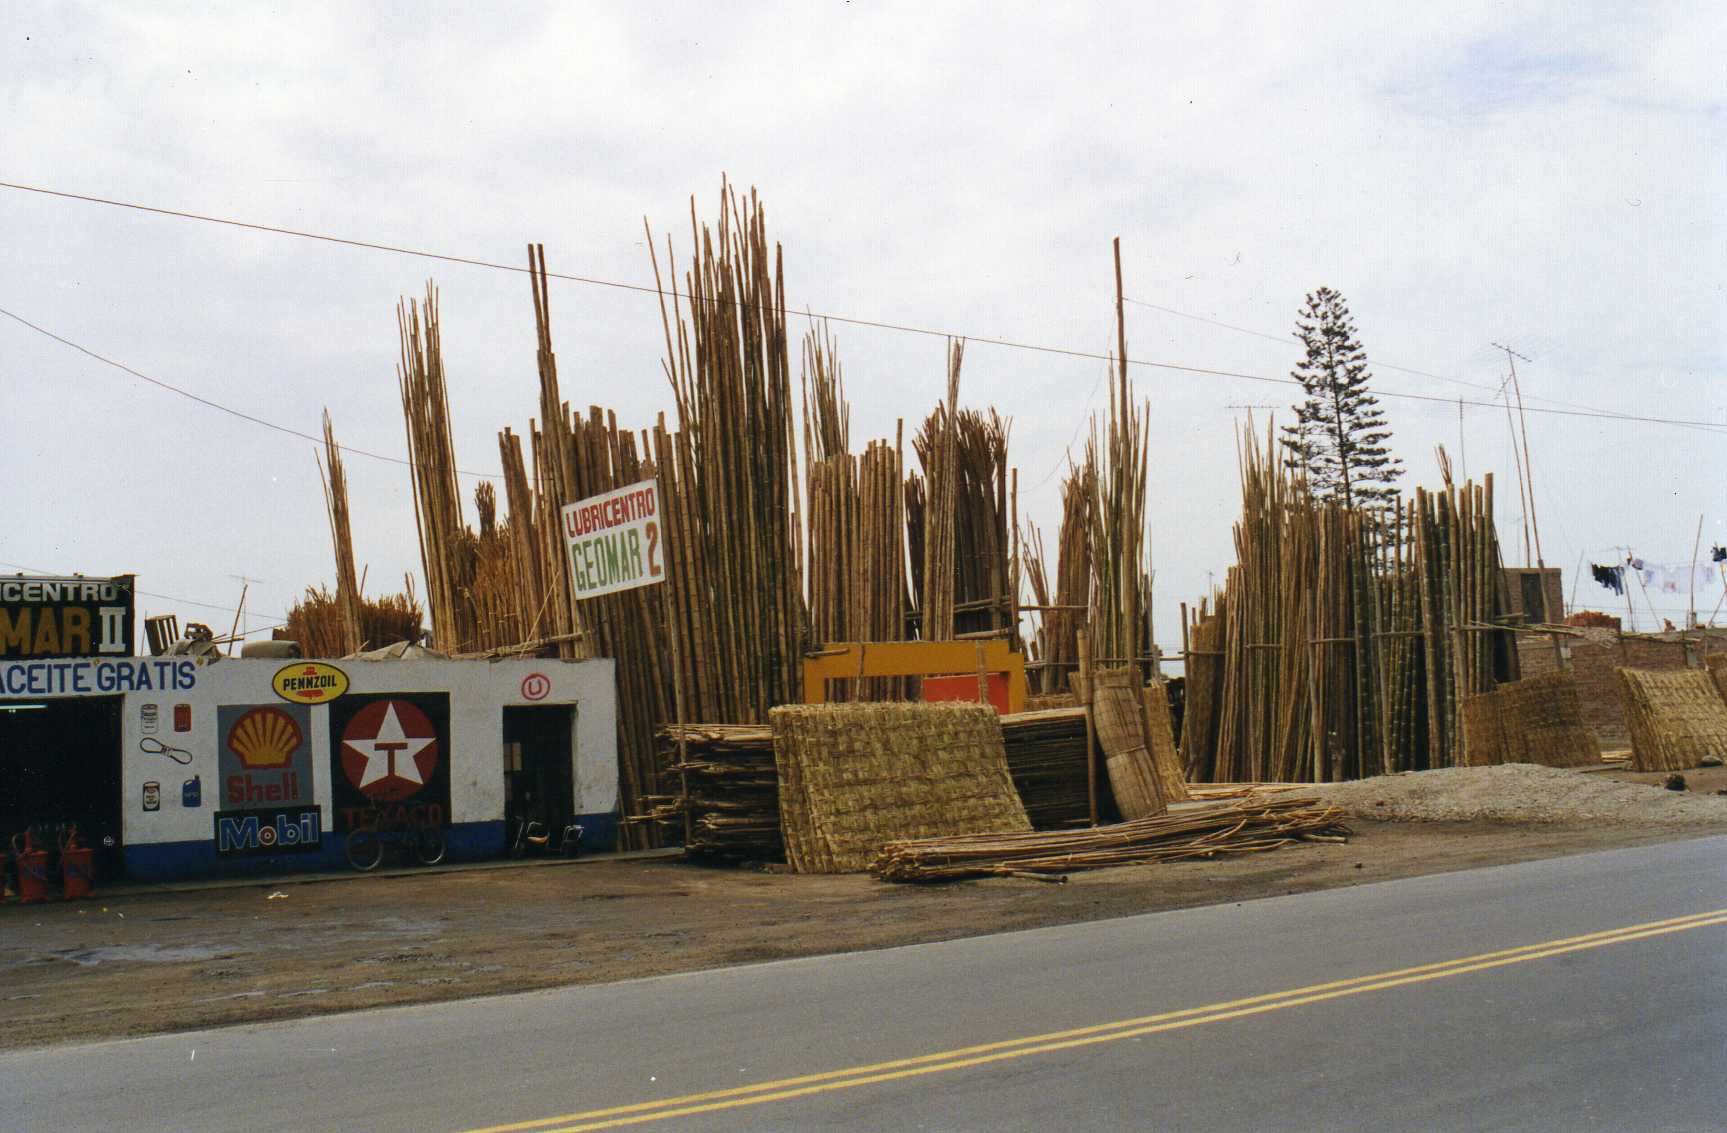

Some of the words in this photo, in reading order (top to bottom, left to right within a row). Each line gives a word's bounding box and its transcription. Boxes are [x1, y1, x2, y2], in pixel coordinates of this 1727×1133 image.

[566, 487, 655, 538] LUBRICENTRO
[572, 528, 643, 592] GEOMAR
[646, 521, 661, 577] 2
[98, 606, 126, 653] II
[97, 661, 196, 691] GRATIS
[283, 674, 337, 691] PENNZOIL
[227, 772, 298, 804] Shell
[219, 812, 319, 851] Mobil
